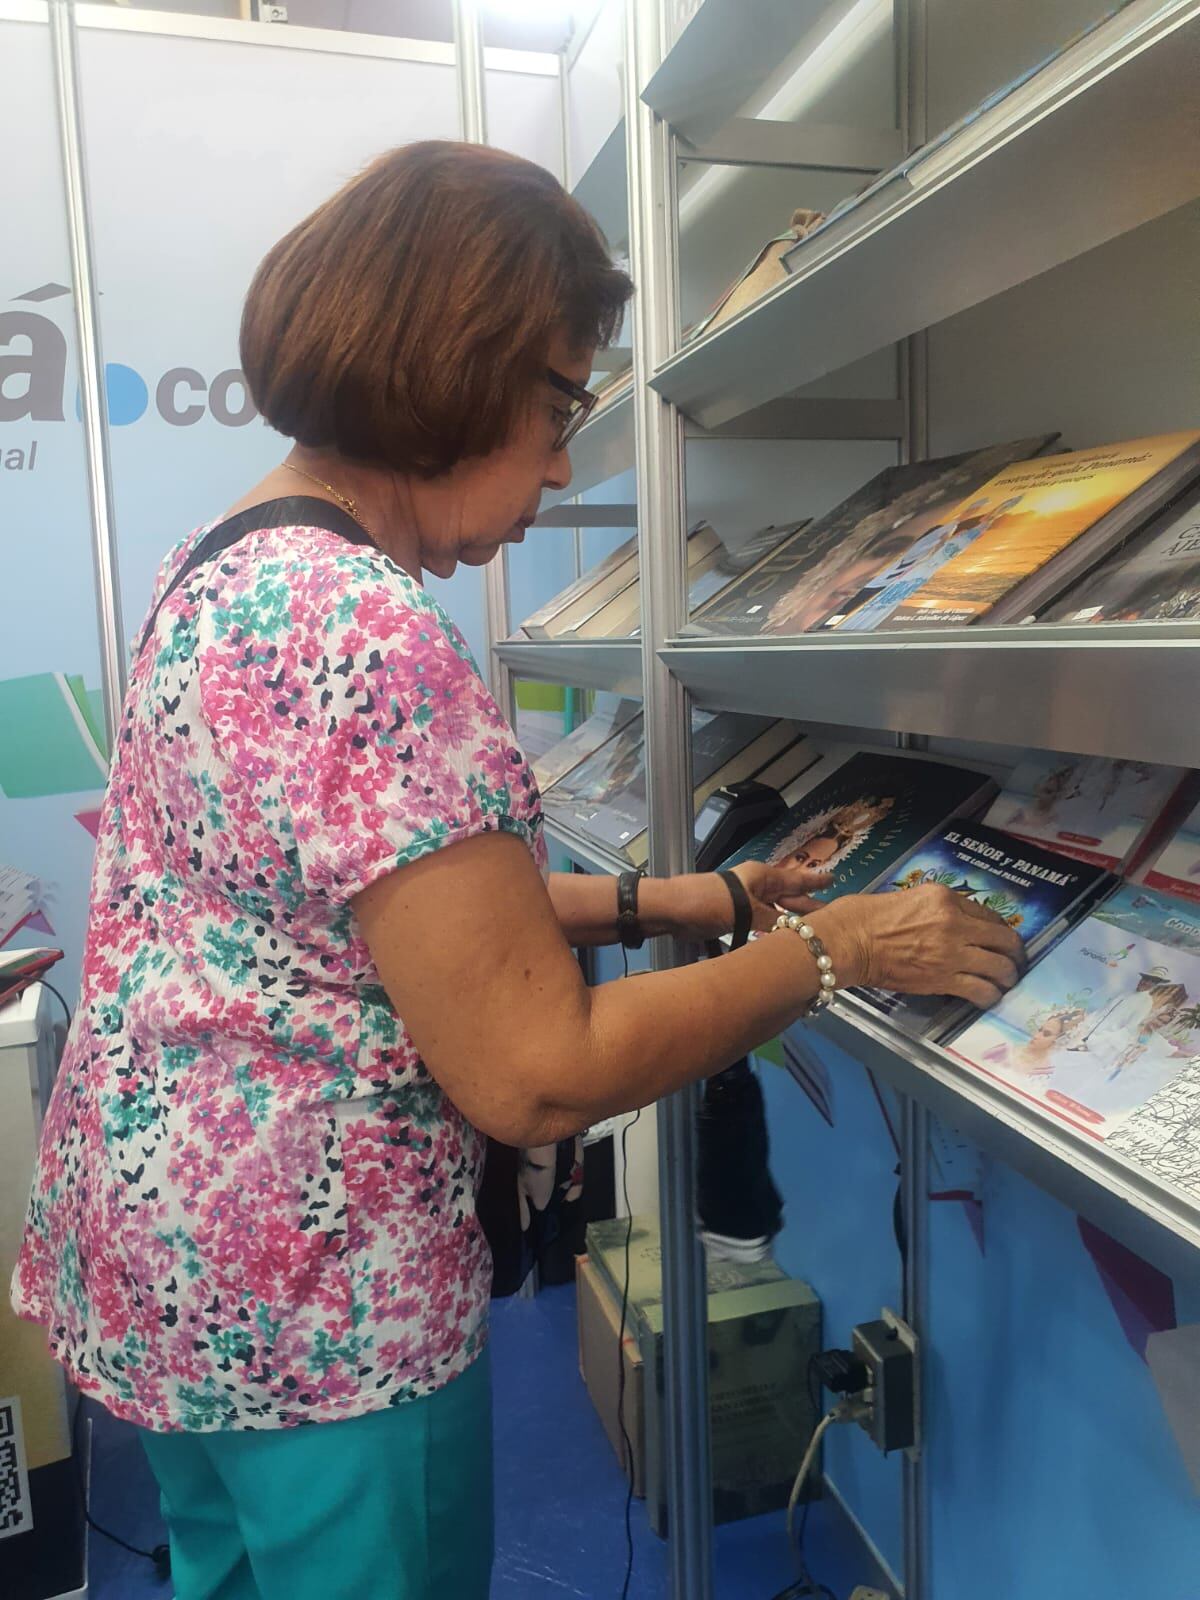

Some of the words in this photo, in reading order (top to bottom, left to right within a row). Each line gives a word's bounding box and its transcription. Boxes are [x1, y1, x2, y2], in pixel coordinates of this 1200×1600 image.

[156, 367, 266, 427] co
[0, 441, 38, 470] al
[944, 831, 961, 844] EL
[959, 837, 1005, 861] SEÑOR
[1000, 857, 1013, 867] y
[957, 852, 970, 862] THE
[970, 858, 991, 871] LORD
